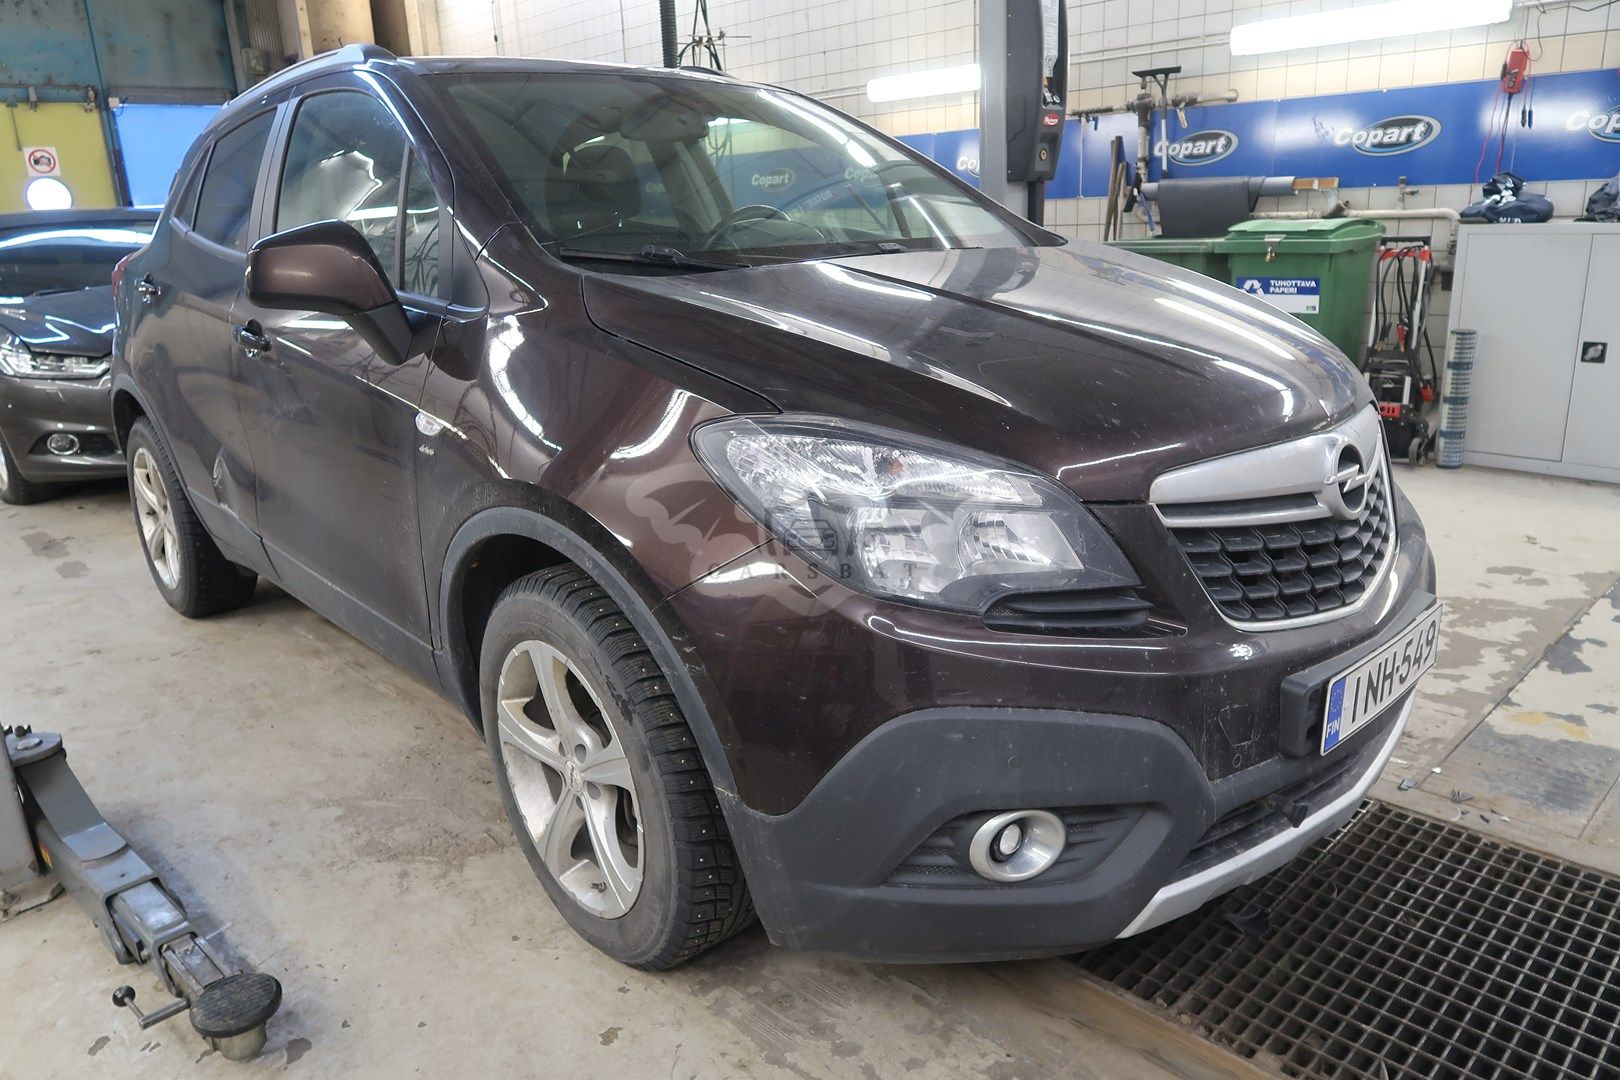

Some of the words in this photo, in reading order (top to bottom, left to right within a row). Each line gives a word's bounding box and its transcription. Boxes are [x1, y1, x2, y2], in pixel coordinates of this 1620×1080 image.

[1333, 120, 1428, 149] Copart
[1154, 136, 1227, 159] Copart
[956, 156, 980, 171] Co
[751, 172, 790, 187] Copart
[1269, 279, 1317, 288] TUHOTTAVA
[1351, 619, 1437, 724] INH-549
[1326, 718, 1341, 738] FIN
